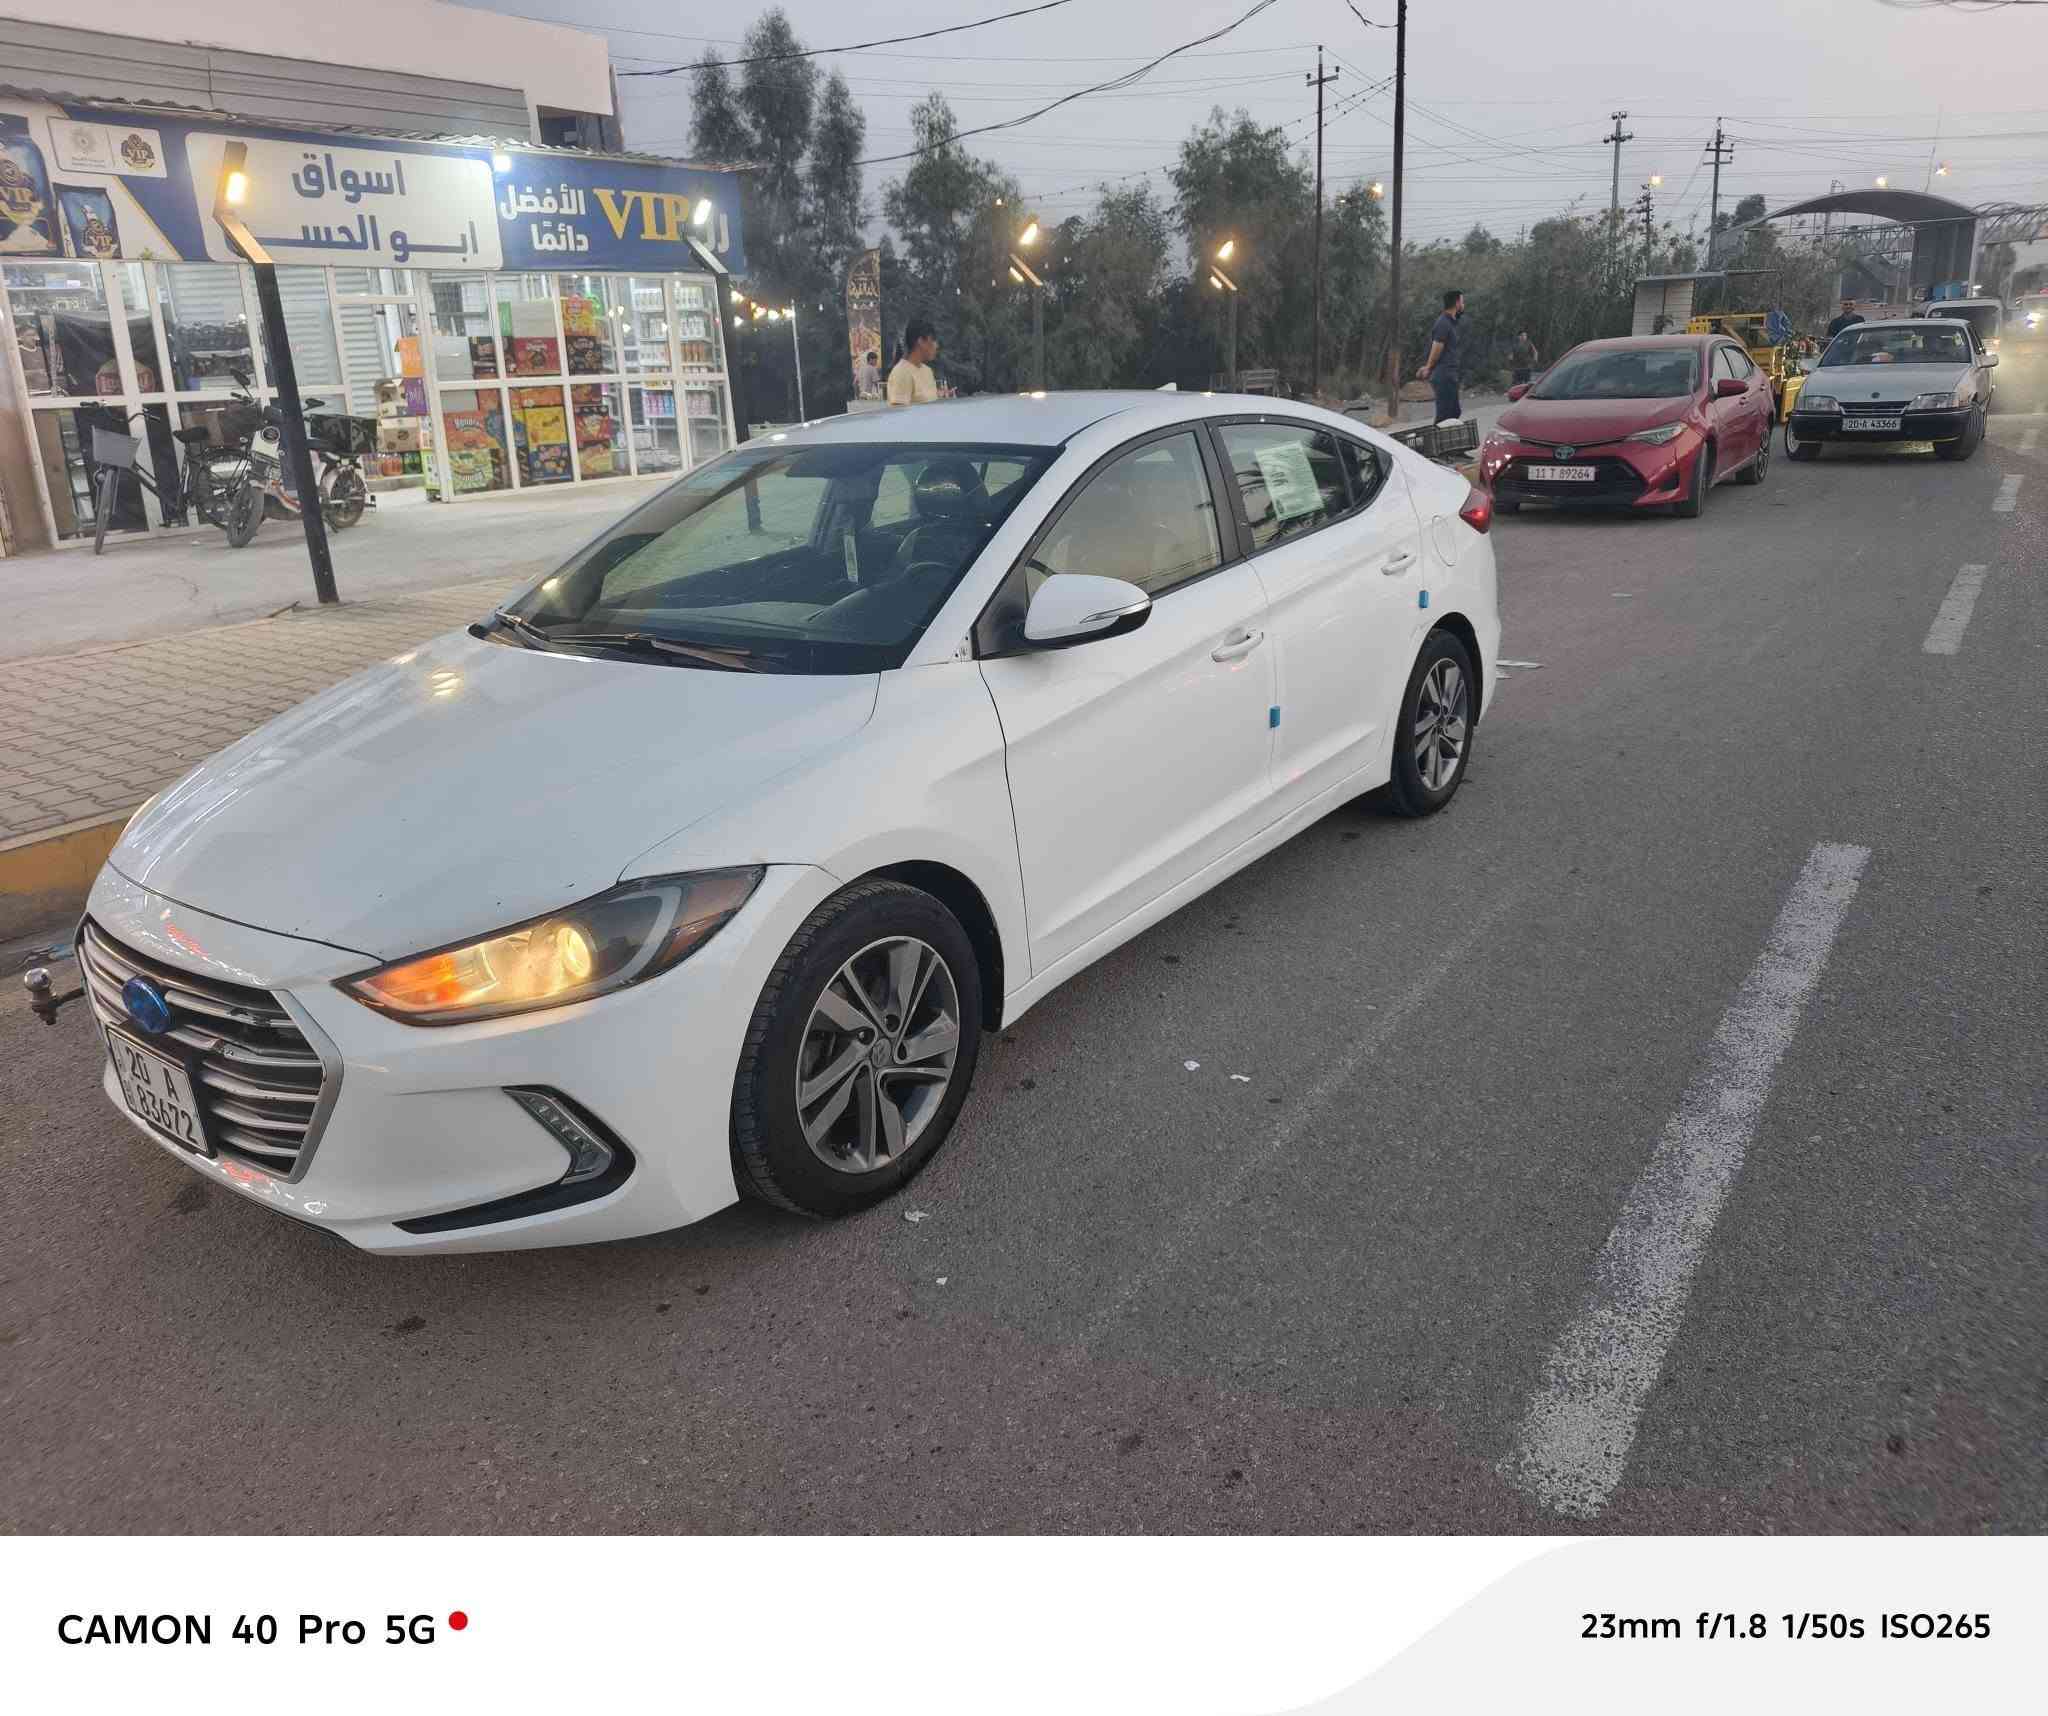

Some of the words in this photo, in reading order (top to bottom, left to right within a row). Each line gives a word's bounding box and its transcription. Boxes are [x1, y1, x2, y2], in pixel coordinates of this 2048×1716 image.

[291, 152, 407, 203] اسواق
[500, 184, 586, 220] الأفضل
[592, 188, 691, 241] VIP
[1535, 467, 1546, 479] 11
[126, 1046, 151, 1085] 20
[162, 1067, 180, 1103] A
[136, 1084, 199, 1145] 83672
